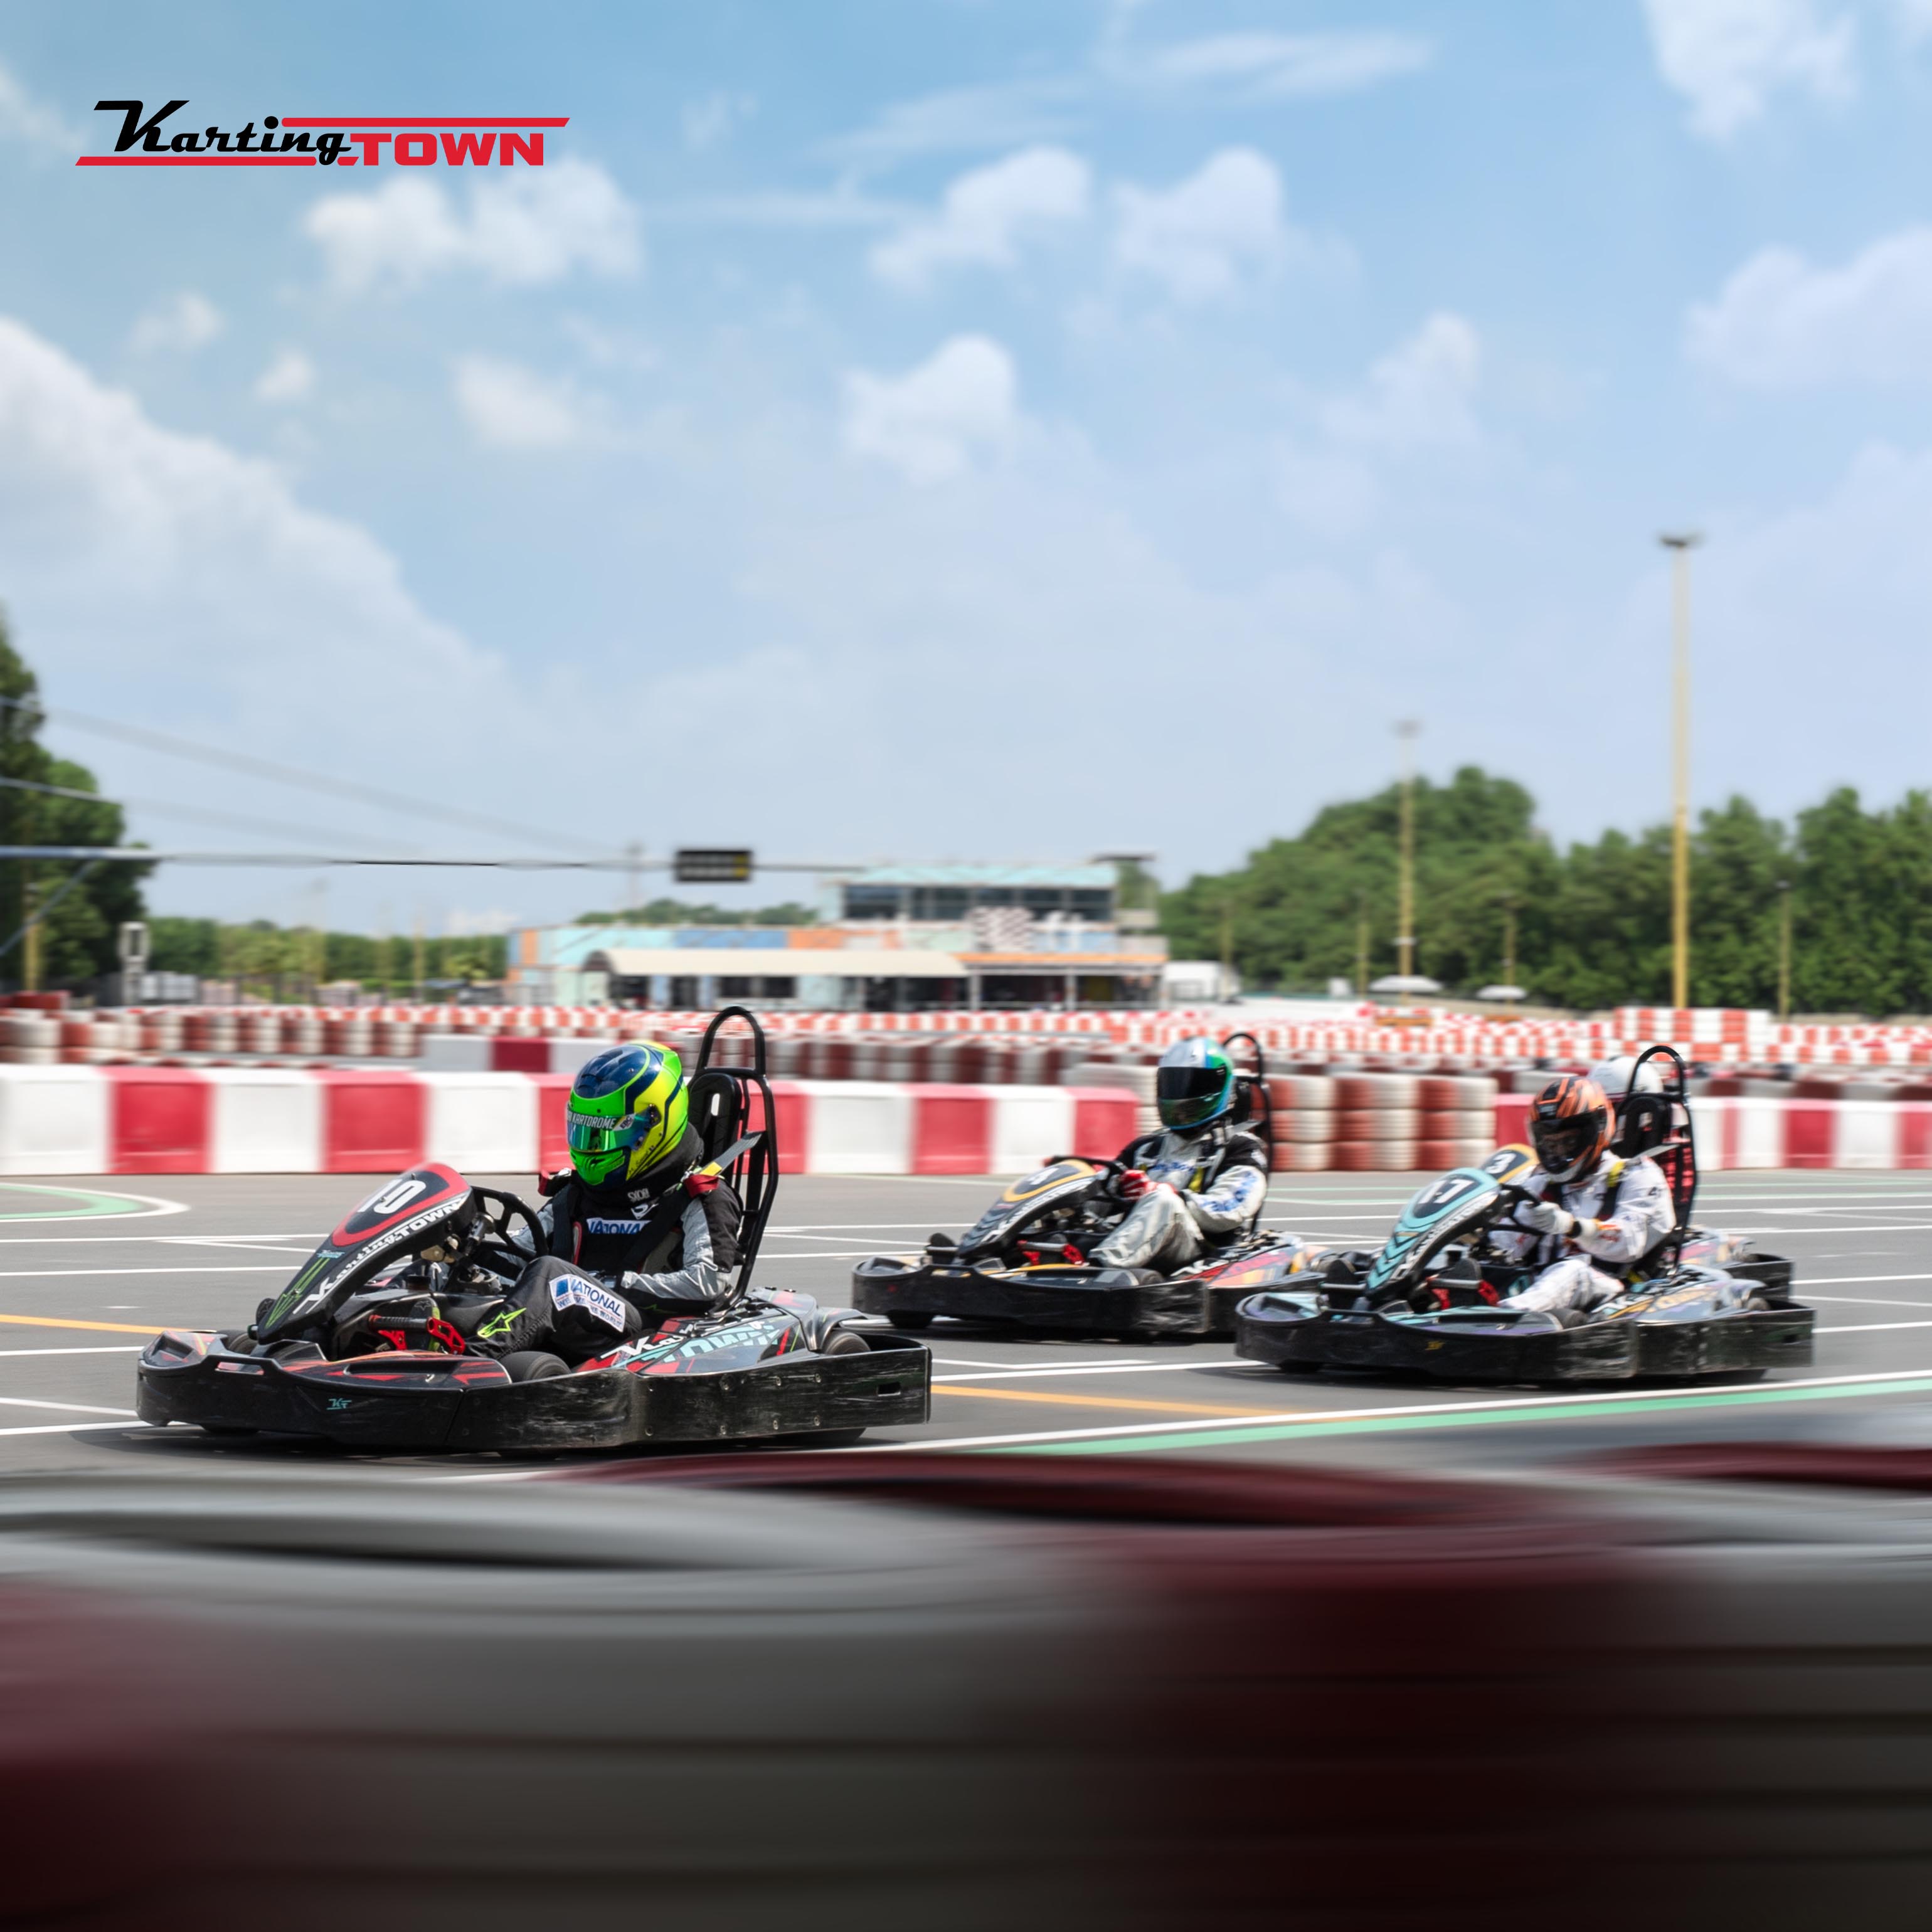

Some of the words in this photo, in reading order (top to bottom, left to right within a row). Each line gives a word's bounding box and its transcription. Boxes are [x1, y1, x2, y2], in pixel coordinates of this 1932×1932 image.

[571, 1113, 617, 1129] KARTDROME
[1485, 1152, 1516, 1174] 3
[1417, 1179, 1475, 1204] 17
